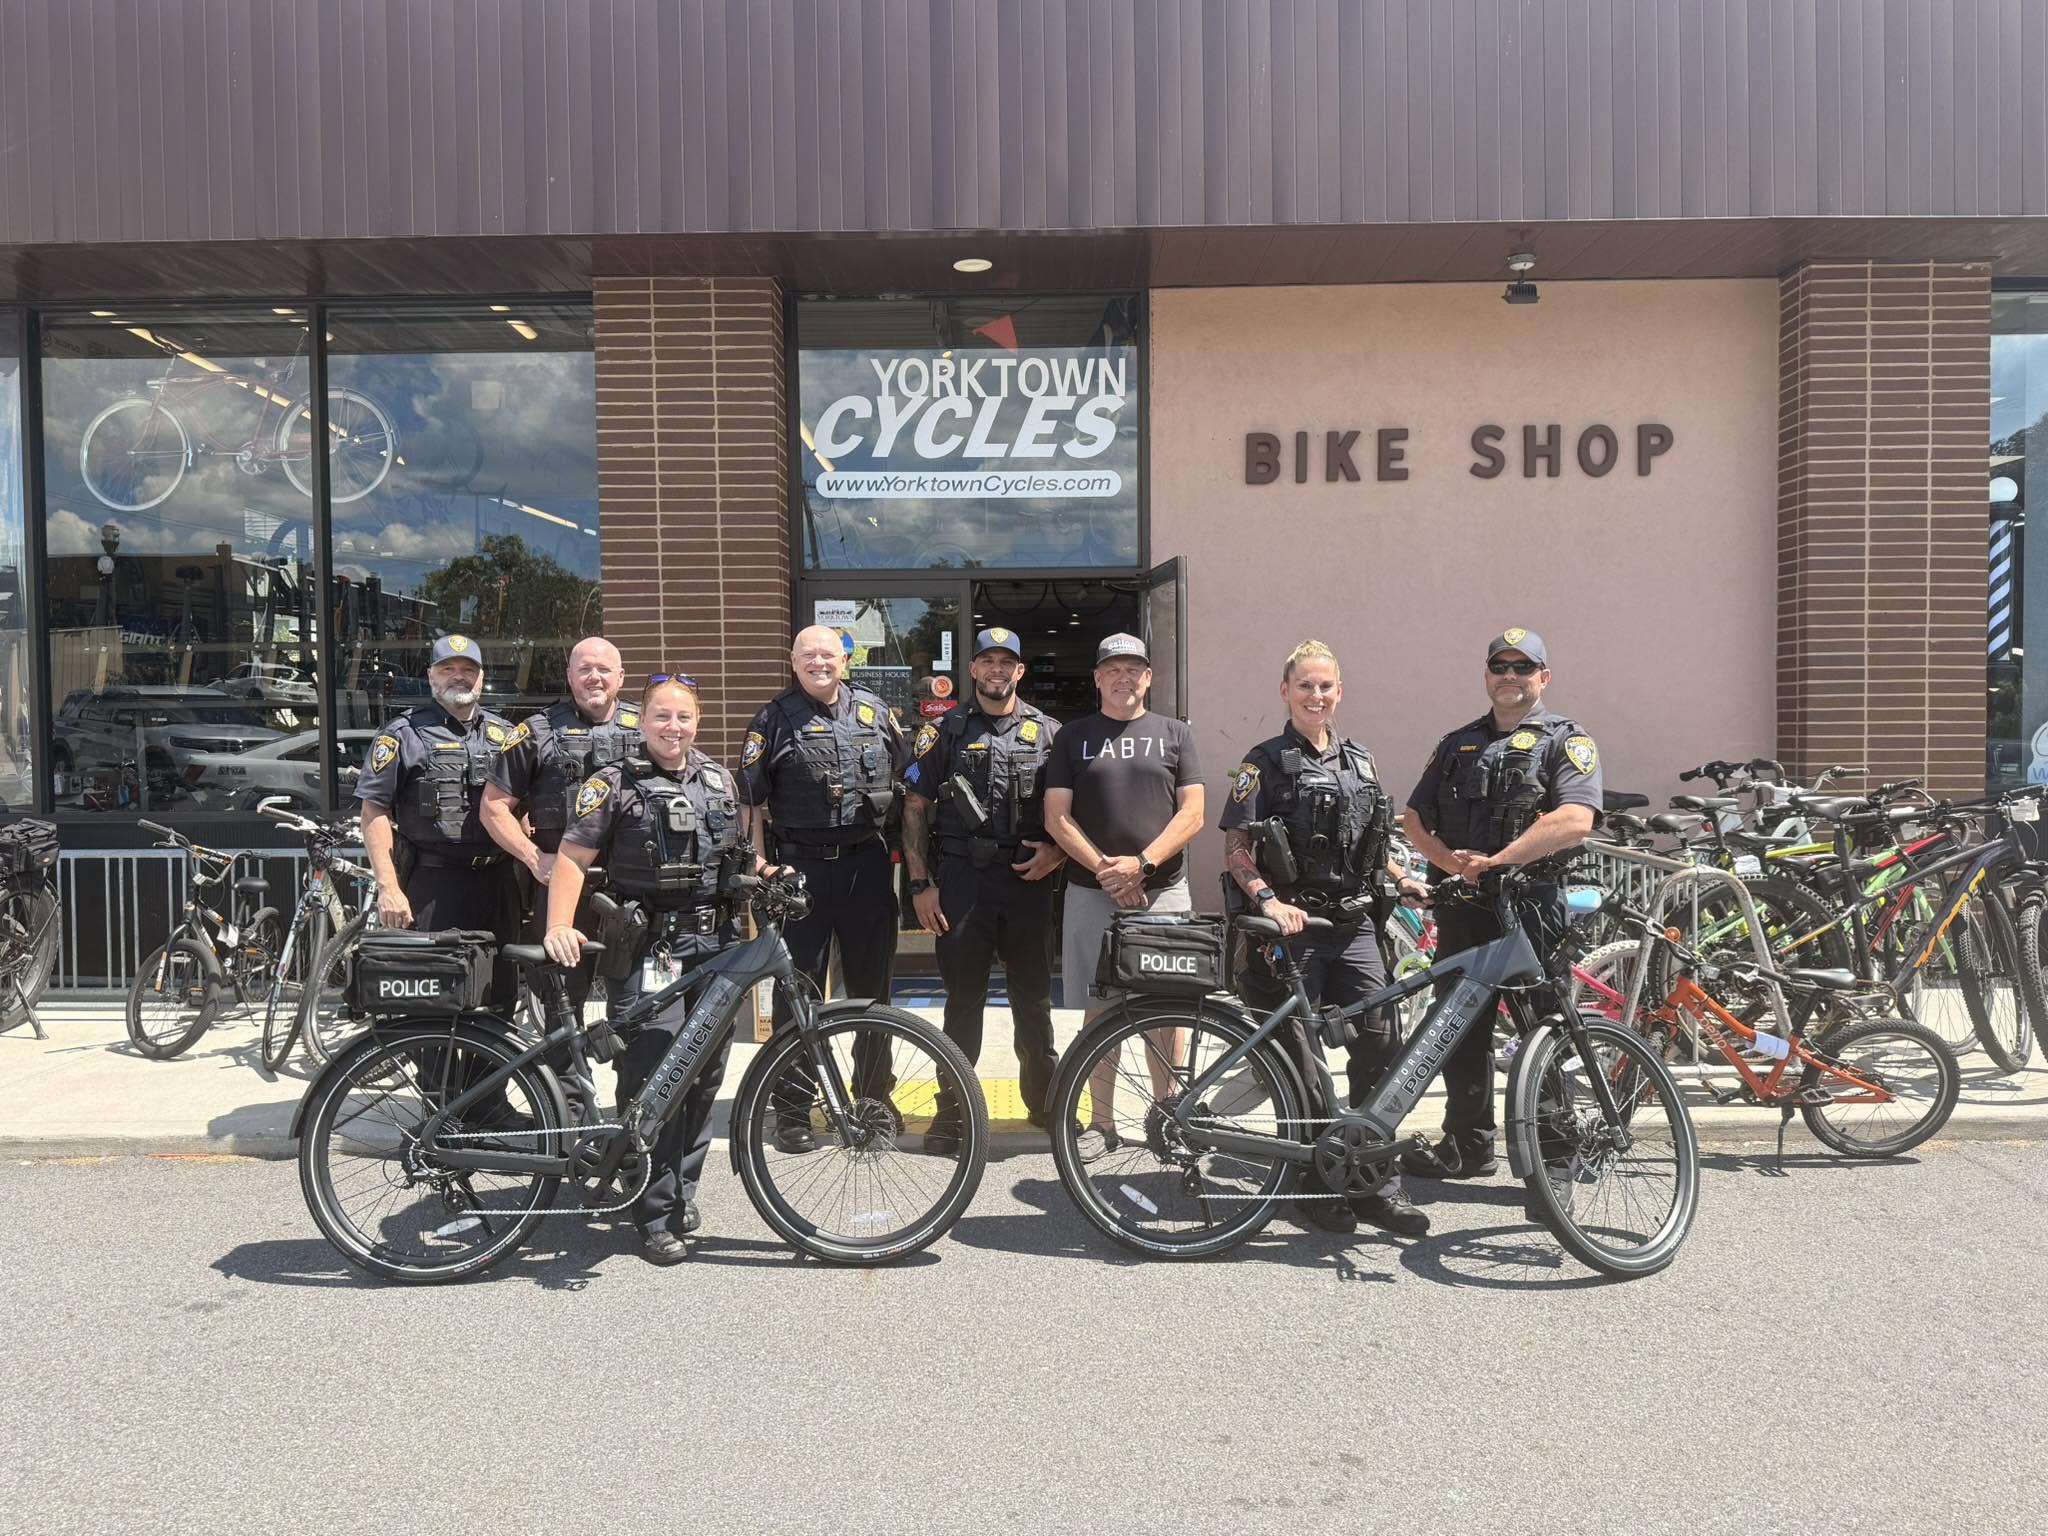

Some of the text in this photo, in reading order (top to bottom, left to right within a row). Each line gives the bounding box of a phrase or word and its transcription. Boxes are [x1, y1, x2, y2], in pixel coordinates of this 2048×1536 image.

[870, 357, 1126, 398] YORKTOWN
[813, 394, 1128, 459] CYCLES
[1245, 423, 1674, 485] BIKE SHOP
[826, 475, 1111, 496] www.YorktownCycles.com
[120, 631, 162, 645] GIANT
[379, 979, 440, 997] POLICE
[1141, 953, 1197, 973] POLICE
[649, 1008, 706, 1092] YORKTOWN
[656, 1013, 720, 1102] POLICE
[1394, 1006, 1453, 1085] YORKTOWN
[1401, 1013, 1468, 1096] POLICE
